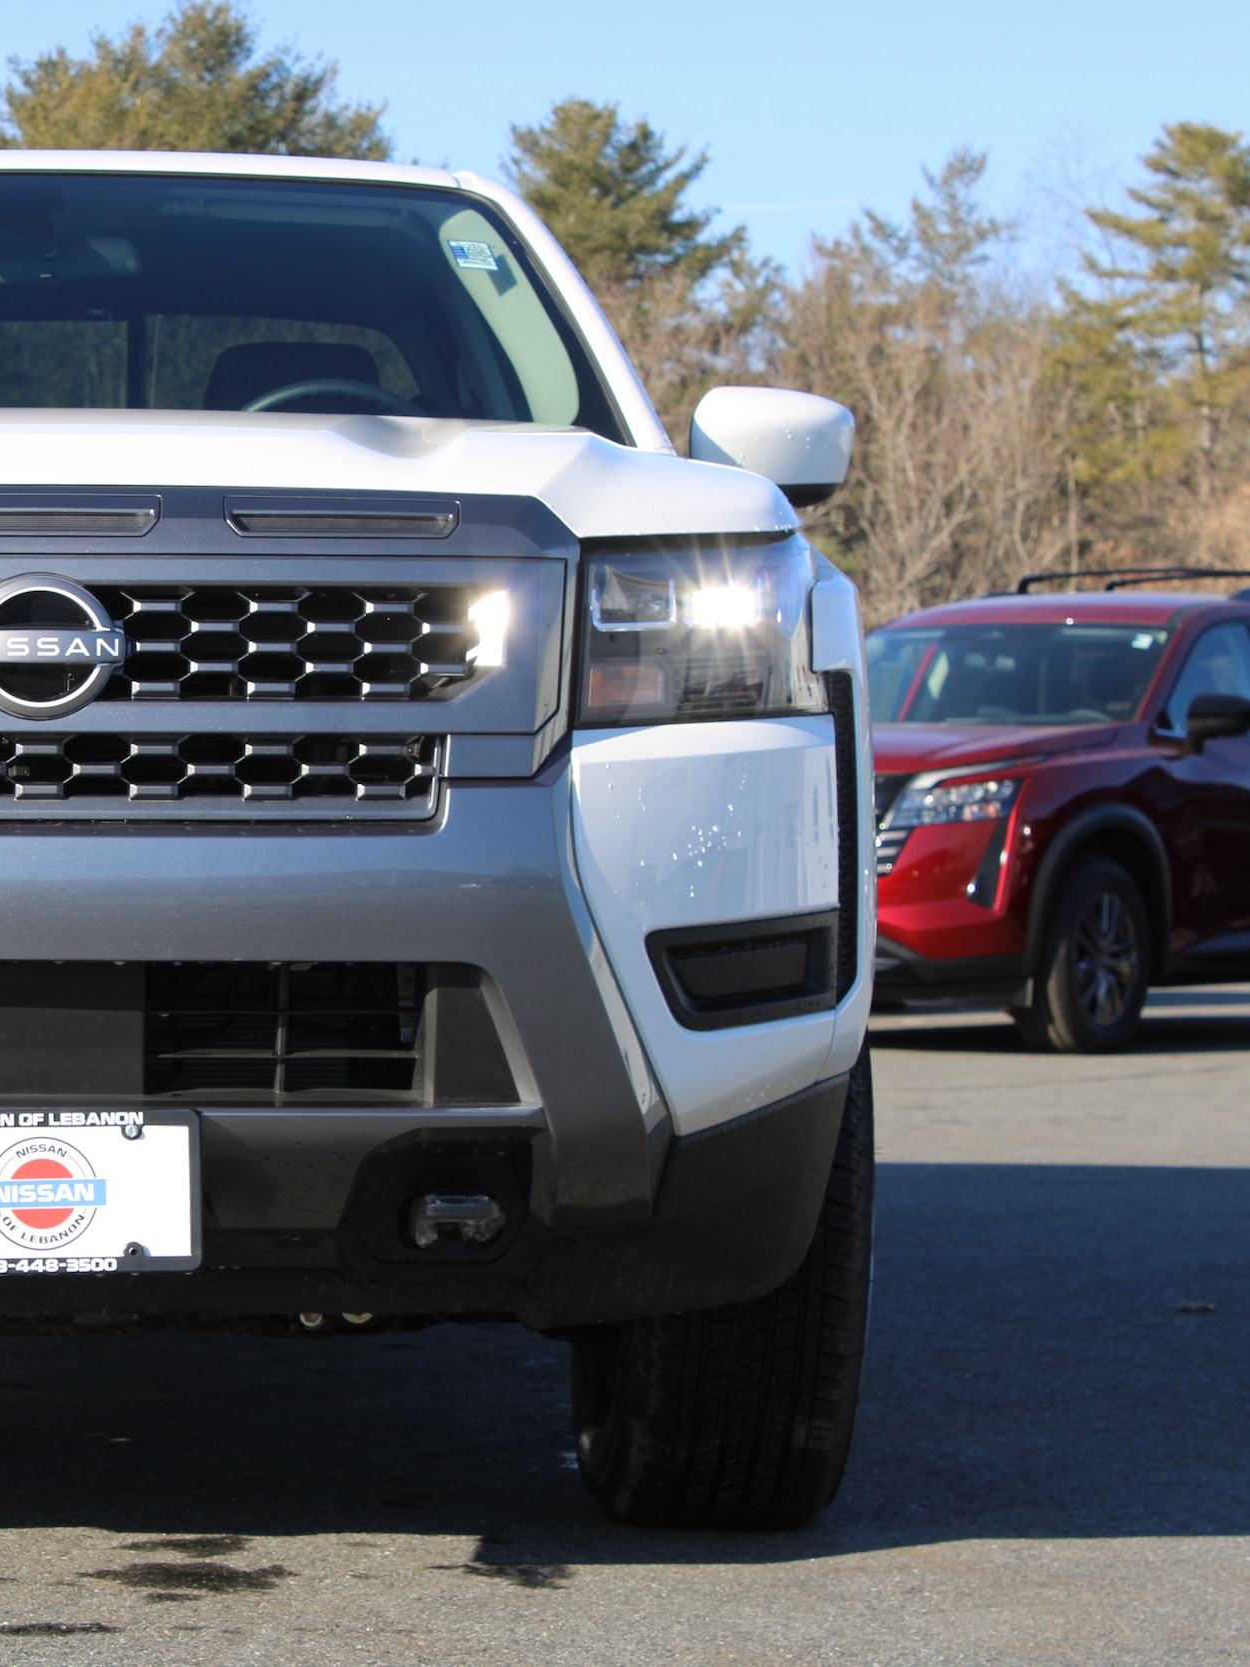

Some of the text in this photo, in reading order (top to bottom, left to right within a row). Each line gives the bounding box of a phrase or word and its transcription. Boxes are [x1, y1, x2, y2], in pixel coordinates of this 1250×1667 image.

[18, 1112, 45, 1127] OF
[48, 1111, 144, 1126] LEBANON
[15, 1143, 68, 1159] NISSAN
[2, 1213, 86, 1245] OF LEBANON
